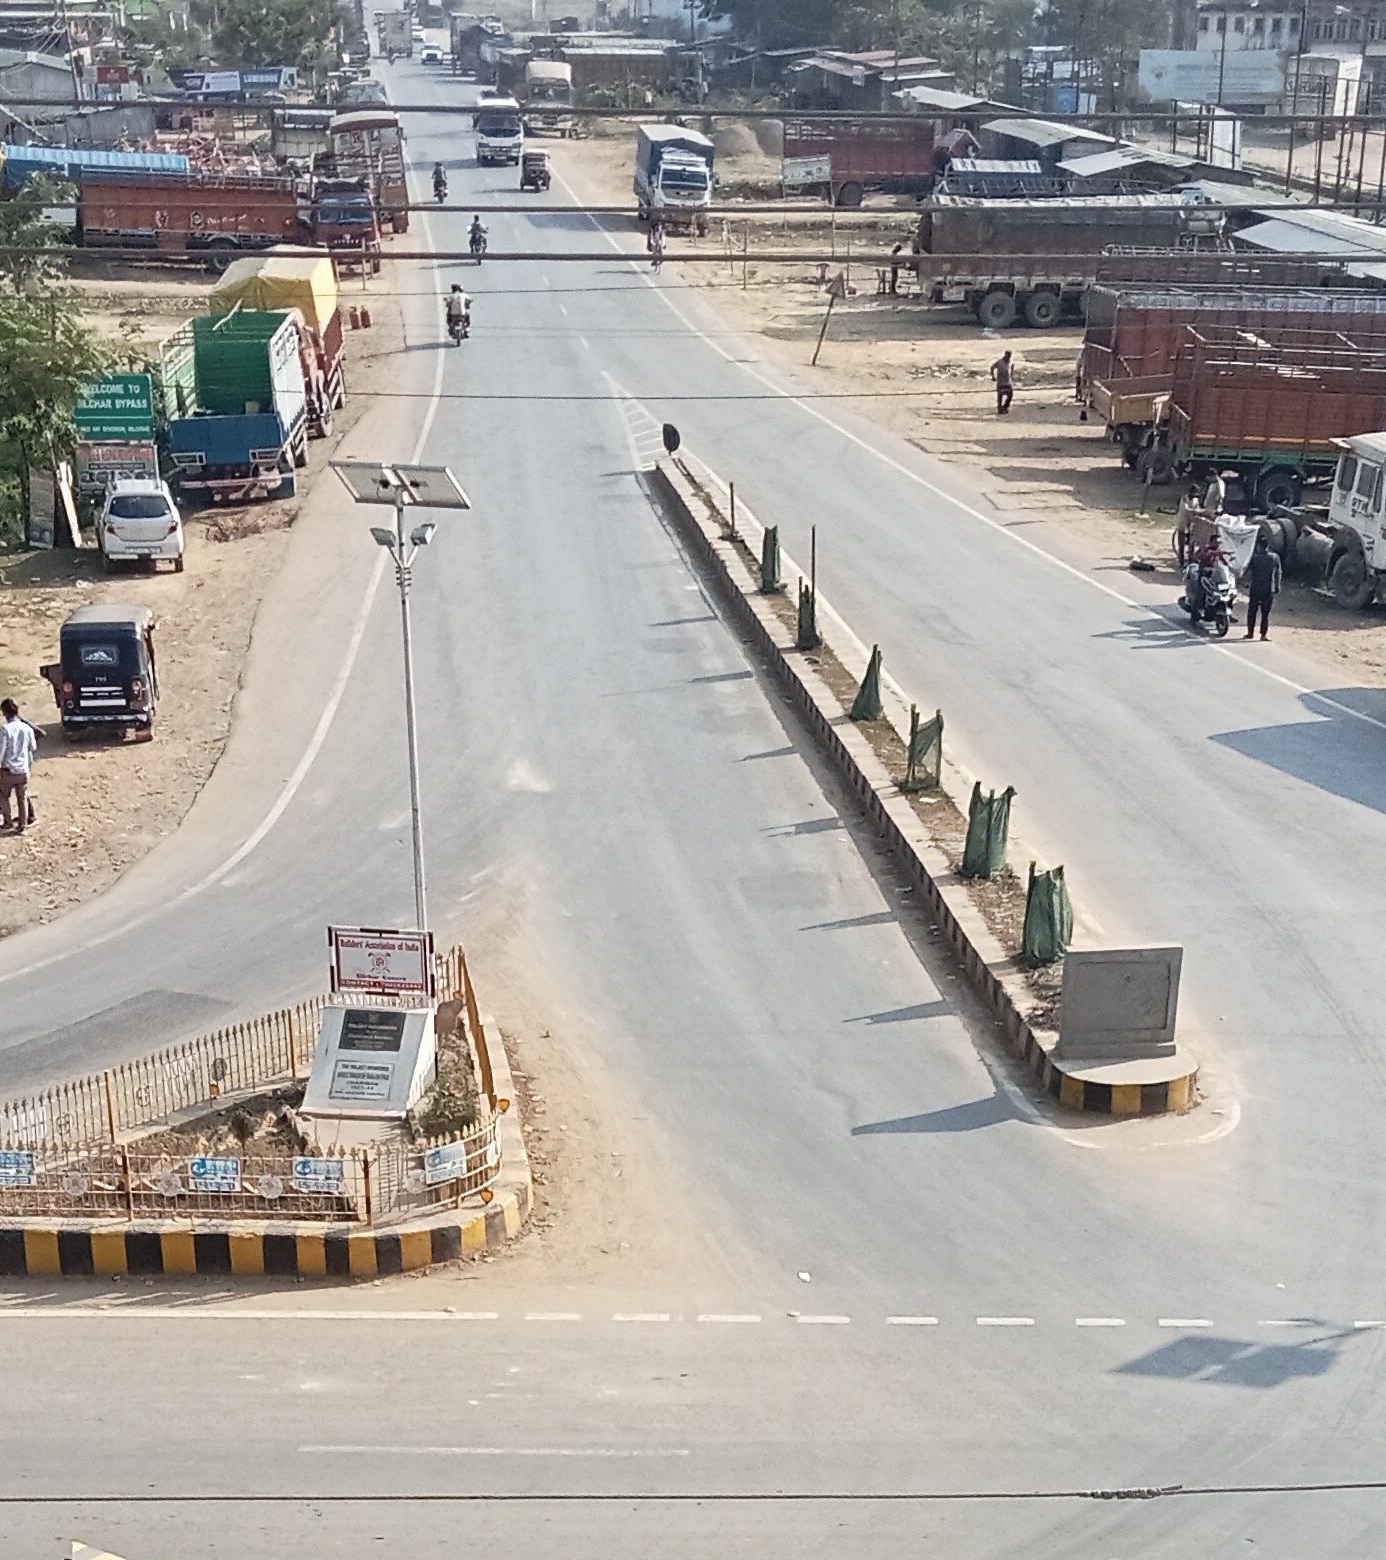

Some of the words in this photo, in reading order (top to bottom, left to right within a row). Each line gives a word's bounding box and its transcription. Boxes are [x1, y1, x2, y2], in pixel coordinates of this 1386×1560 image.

[128, 384, 140, 394] TO
[115, 399, 147, 409] BYPASS
[398, 941, 404, 950] of
